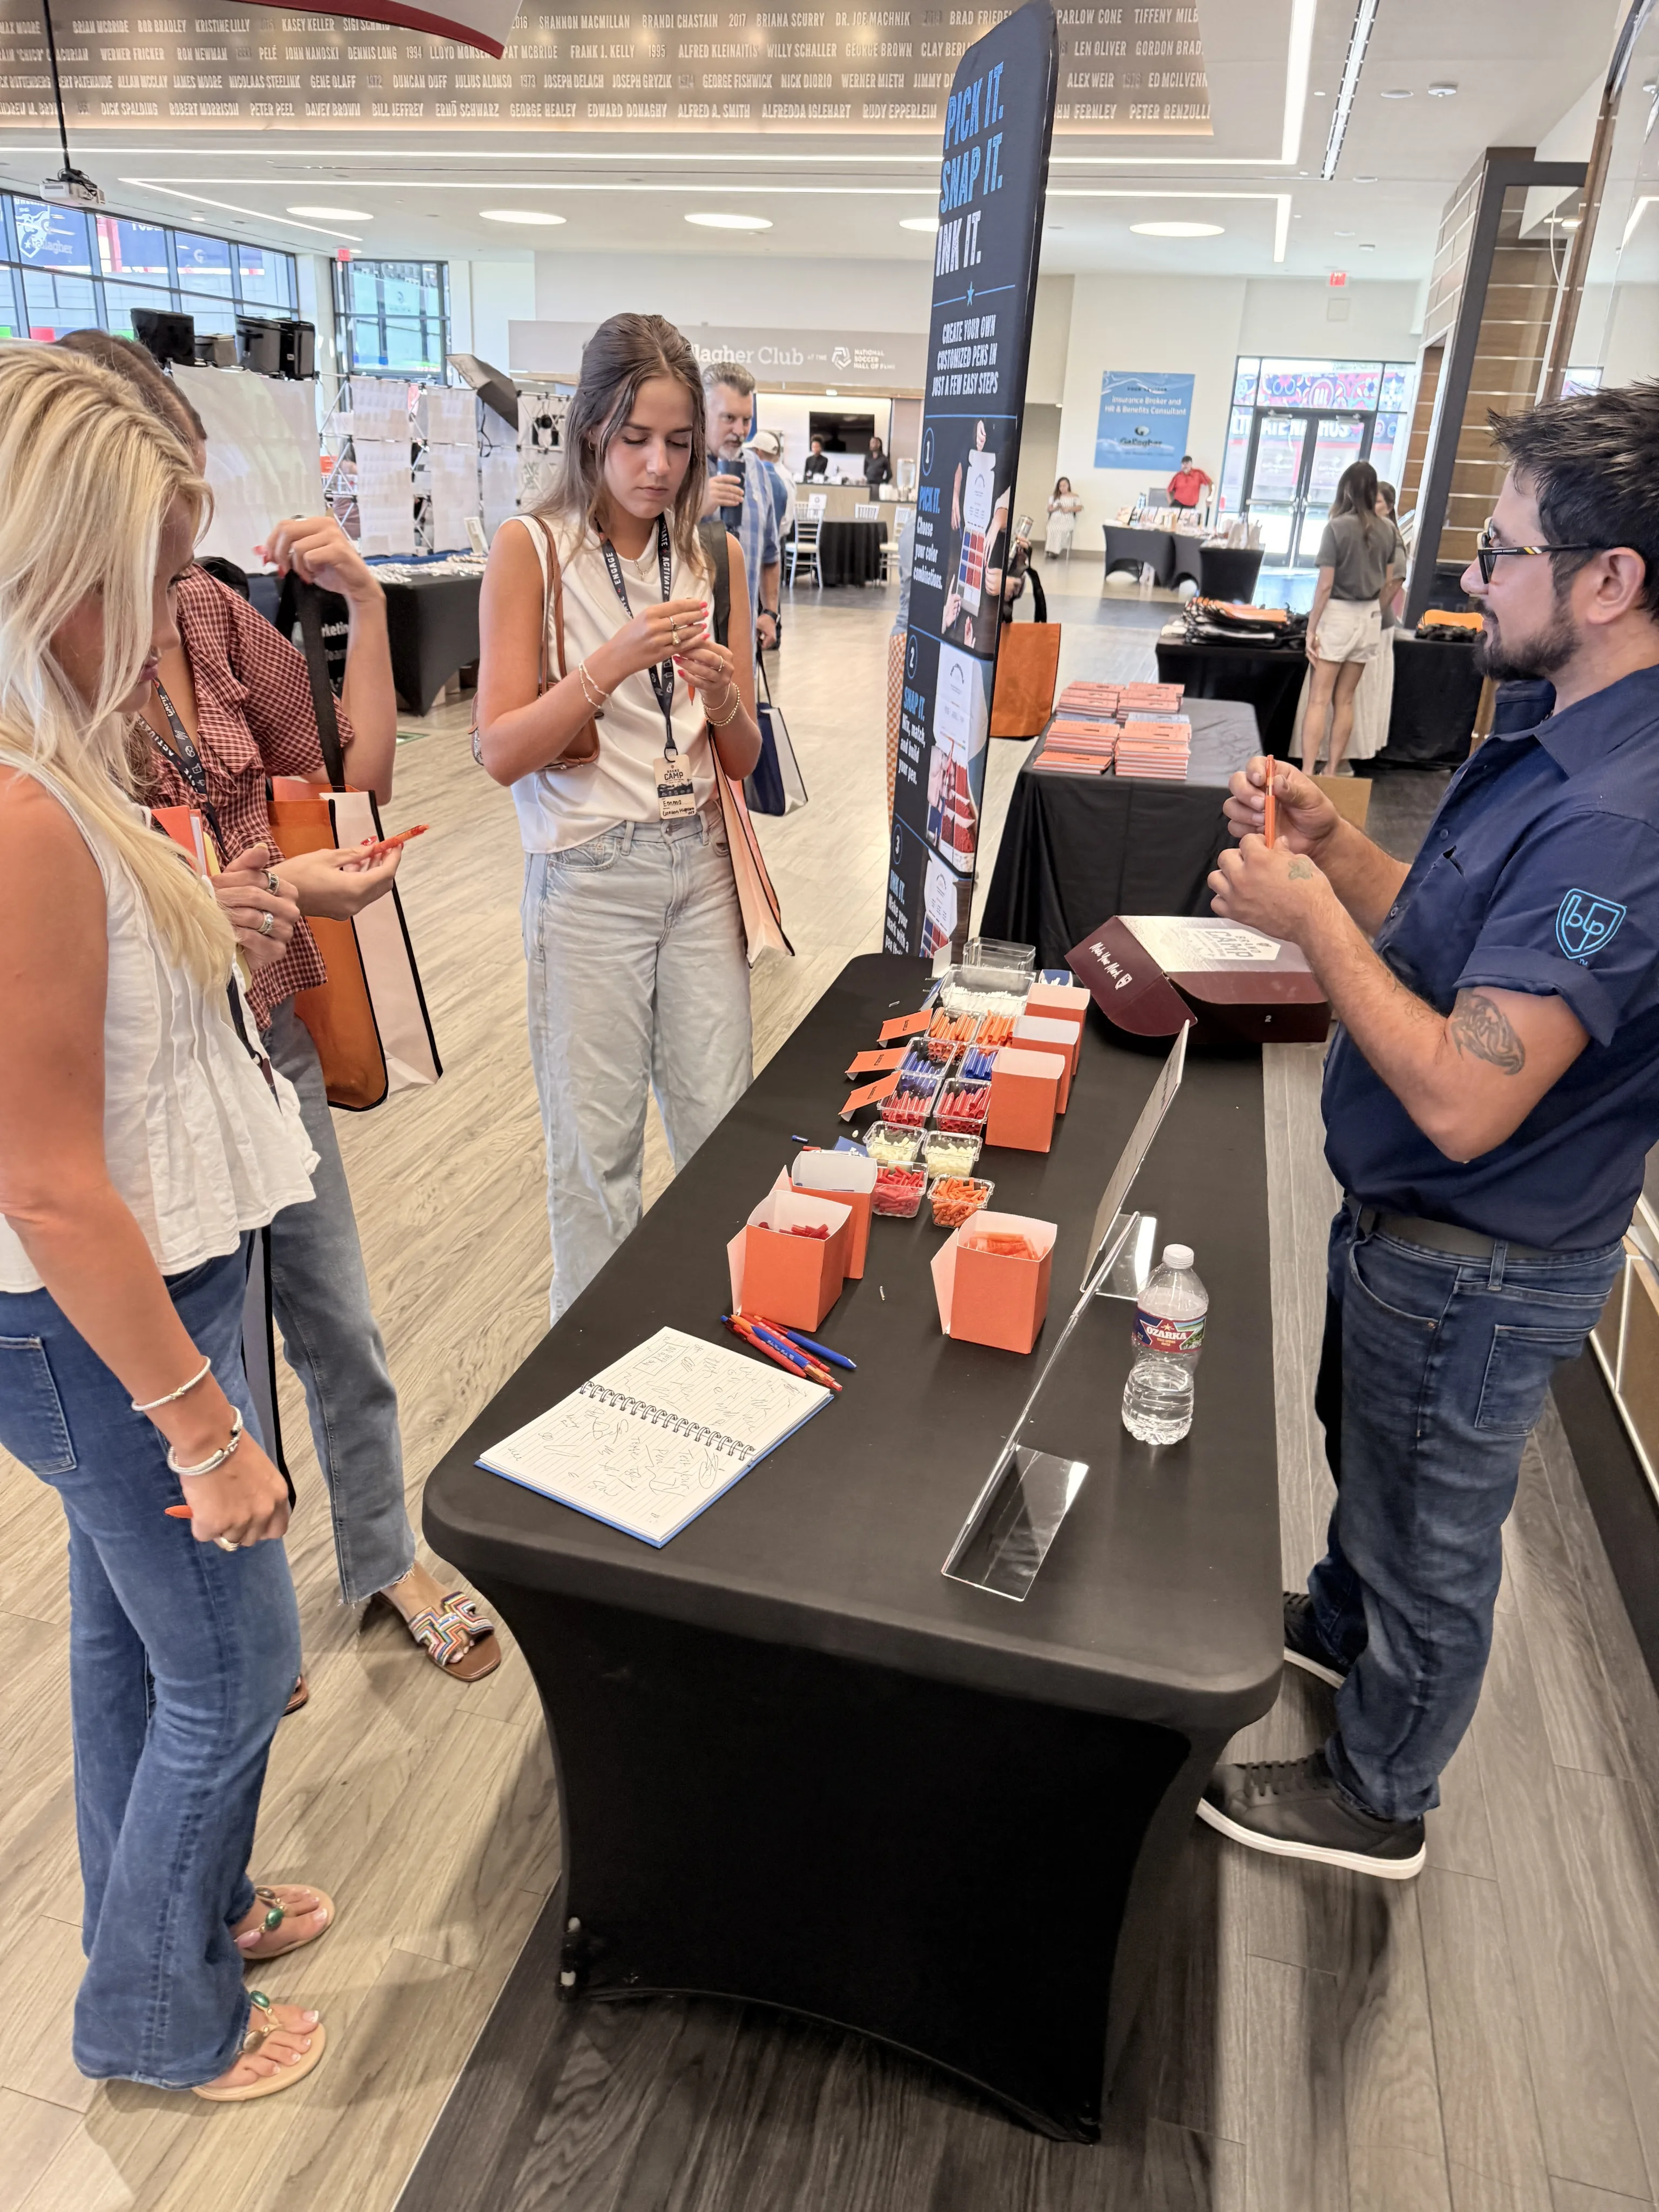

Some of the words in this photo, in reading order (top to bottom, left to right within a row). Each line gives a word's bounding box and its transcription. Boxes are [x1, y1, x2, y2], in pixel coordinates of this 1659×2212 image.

[137, 19, 153, 32] BOB
[154, 19, 186, 32] BRADLEY
[230, 19, 249, 32] LILLY
[282, 18, 306, 31] KASEY
[307, 18, 335, 31] KELLER
[343, 18, 359, 31] SIGI
[539, 16, 578, 29] SHANNON
[581, 15, 630, 29] MACMILLAN
[643, 14, 674, 28] BRANDI
[677, 14, 718, 28] CHASTAIN
[729, 14, 746, 27] 2017
[757, 13, 788, 27] BRIANA
[791, 13, 825, 26] SCURRY
[836, 12, 849, 26] DR.
[853, 12, 867, 26] JOE
[869, 11, 911, 26] MACHNIK
[950, 11, 974, 25] BRAD
[1057, 9, 1095, 24] PARLOW
[1098, 9, 1122, 23] CONE
[1135, 9, 1172, 23] TIFFENY
[286, 46, 304, 60] JOHN
[306, 46, 339, 59] NANOSKI
[348, 46, 375, 59] DENNIS
[377, 46, 396, 59] LONG
[406, 46, 422, 59] 1994
[430, 46, 454, 59] LLOYD
[521, 45, 557, 58] MCBRIDE
[570, 45, 598, 58] FRANK
[601, 45, 608, 58] J.
[610, 45, 635, 58] KELLY
[649, 44, 665, 58] 1995
[679, 44, 709, 58] ALFRED
[712, 44, 758, 58] KLEINAITIS
[767, 44, 792, 57] WILLY
[794, 43, 837, 57] SCHALLER
[846, 43, 878, 57] GEORGE
[881, 43, 912, 57] BROWN
[921, 42, 943, 56] CLAY
[1075, 41, 1091, 56] LEN
[1094, 41, 1126, 55] OLIVER
[1136, 41, 1174, 55] GORDON
[229, 76, 265, 88] NICOLAAS
[266, 75, 300, 87] STEELINK
[311, 75, 331, 88] GENE
[332, 75, 356, 88] OLAFF
[393, 75, 425, 88] DUNCAN
[428, 75, 448, 88] DUFF
[455, 75, 481, 88] JULIUS
[482, 75, 512, 88] ALONSO
[521, 75, 536, 87] 1973
[544, 75, 572, 88] JOSEPH
[574, 75, 604, 88] DELACH
[612, 74, 641, 88] JOSEPH
[643, 74, 672, 88] GRYZIK
[703, 74, 732, 88] GEORGE
[734, 74, 772, 88] FISHWICK
[781, 74, 801, 87] NICK
[804, 74, 832, 87] DIORIO
[841, 73, 876, 87] WERNER
[878, 73, 905, 87] MIETH
[914, 73, 941, 87] JIMMY
[1067, 73, 1090, 87] ALEX
[1091, 72, 1115, 87] WEIR
[1148, 72, 1161, 87] ED
[250, 103, 274, 116] PETER
[372, 103, 390, 116] BILL
[392, 103, 423, 116] JEFFREY
[460, 103, 499, 117] SCHWARZ
[510, 103, 541, 117] GEORGE
[545, 103, 576, 117] HEALEY
[588, 103, 623, 117] EDWARD
[626, 103, 667, 117] DONAGHY
[678, 104, 710, 117] ALFRED
[712, 104, 720, 117] A.
[723, 104, 750, 117] SMITH
[762, 104, 806, 118] ALFREDDA
[808, 104, 851, 118] IGLEHART
[863, 104, 886, 118] RUDY
[888, 104, 937, 118] EPPERLEIN
[1074, 104, 1117, 119] FERNLEY
[1130, 104, 1159, 119] PETER
[945, 77, 982, 149] PICK
[984, 62, 1003, 128] IT.
[941, 146, 981, 213] SNAP
[983, 132, 1003, 195] IT.
[936, 218, 962, 277] INK
[963, 211, 981, 268] IT.
[942, 321, 963, 344] CREATE
[963, 318, 980, 341] YOUR
[981, 314, 996, 338] OWN
[758, 347, 804, 365] Club
[937, 346, 972, 370] CUSTOMIZED
[972, 344, 988, 367] PENS
[989, 343, 997, 365] IN
[932, 376, 945, 396] JUST
[945, 375, 949, 395] A
[950, 374, 962, 395] FEW
[962, 373, 978, 395] EASY
[979, 372, 999, 394] STEPS
[1145, 396, 1167, 404] Broker
[1150, 407, 1186, 415] Consultant
[919, 485, 933, 512] PICK
[917, 516, 933, 537] Choose
[914, 543, 926, 561] your
[926, 543, 938, 563] color
[606, 552, 622, 585] ENGAGE
[662, 557, 670, 595] ACTIVATE
[913, 564, 942, 590] combinations.
[664, 772, 683, 780] CAMP
[1089, 942, 1106, 956] Make
[1205, 931, 1253, 957] CAMP
[1097, 952, 1111, 965] Your
[1147, 1326, 1187, 1339] OZARKA
